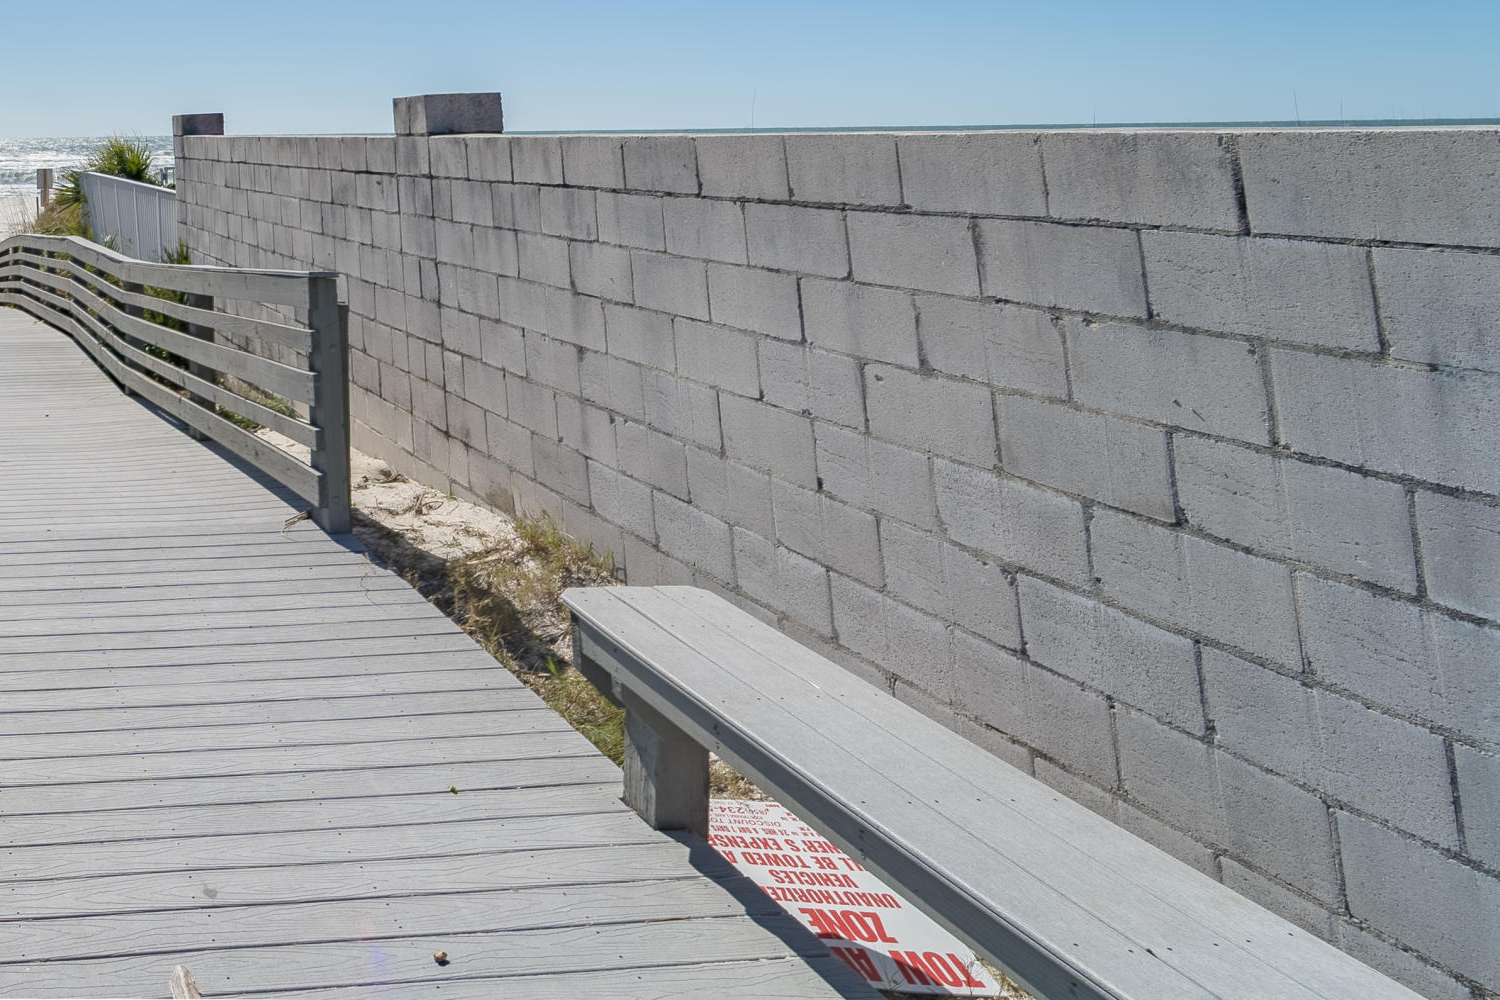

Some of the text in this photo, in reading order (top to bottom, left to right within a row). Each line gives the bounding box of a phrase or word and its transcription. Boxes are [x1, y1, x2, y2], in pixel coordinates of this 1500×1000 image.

[728, 818, 781, 827] DISCOUNT
[740, 852, 810, 868] TOWED
[810, 856, 839, 870] BE
[768, 869, 859, 888] VEHICLES
[798, 907, 898, 944] ZONE
[888, 950, 986, 988] TOW
